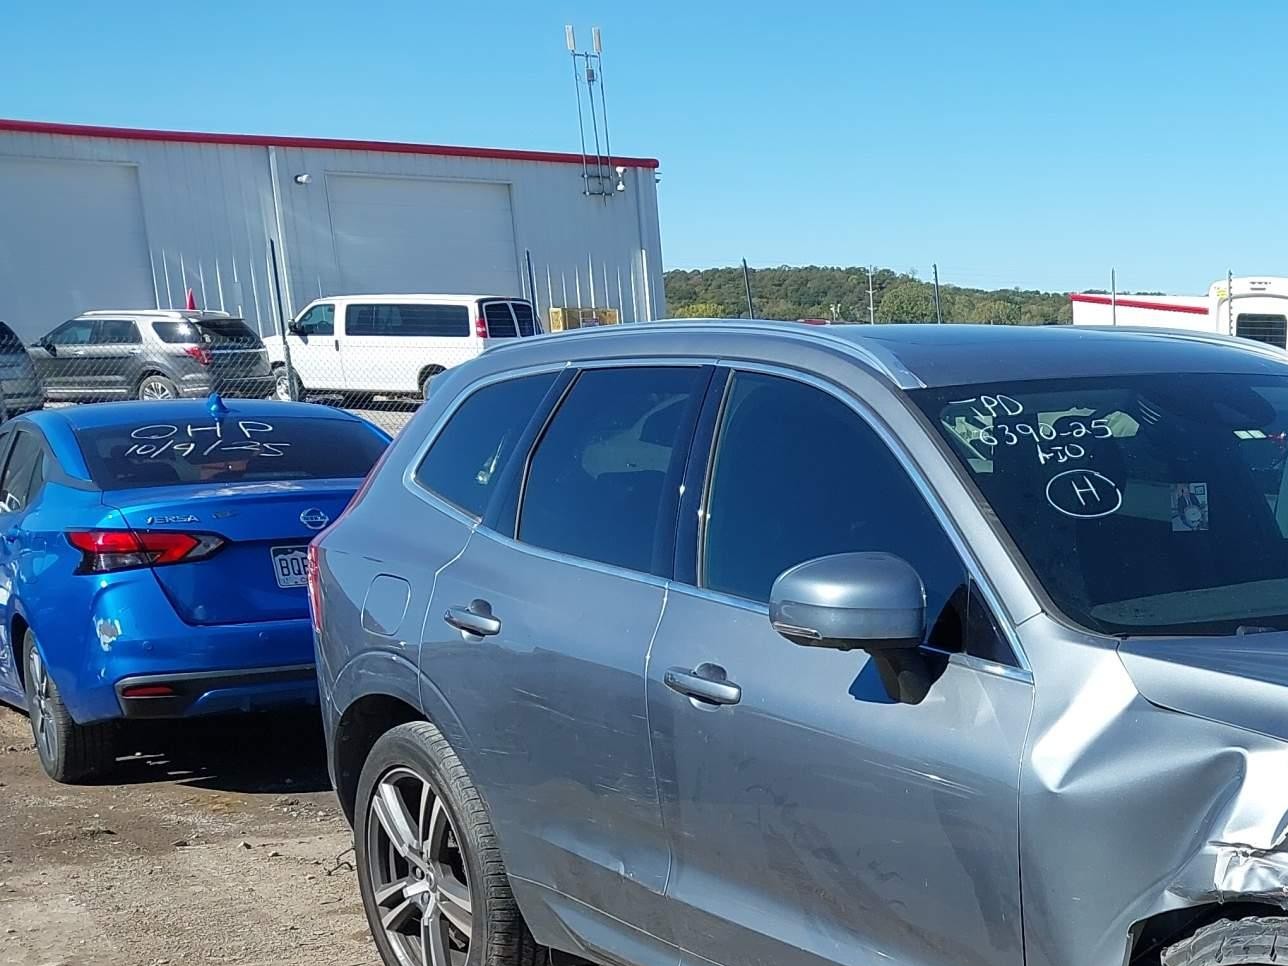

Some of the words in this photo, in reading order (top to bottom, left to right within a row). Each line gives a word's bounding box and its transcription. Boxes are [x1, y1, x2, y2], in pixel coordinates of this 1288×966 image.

[979, 419, 1113, 445] 6390-25
[124, 439, 291, 459] 10/9/25
[1071, 475, 1101, 506] H
